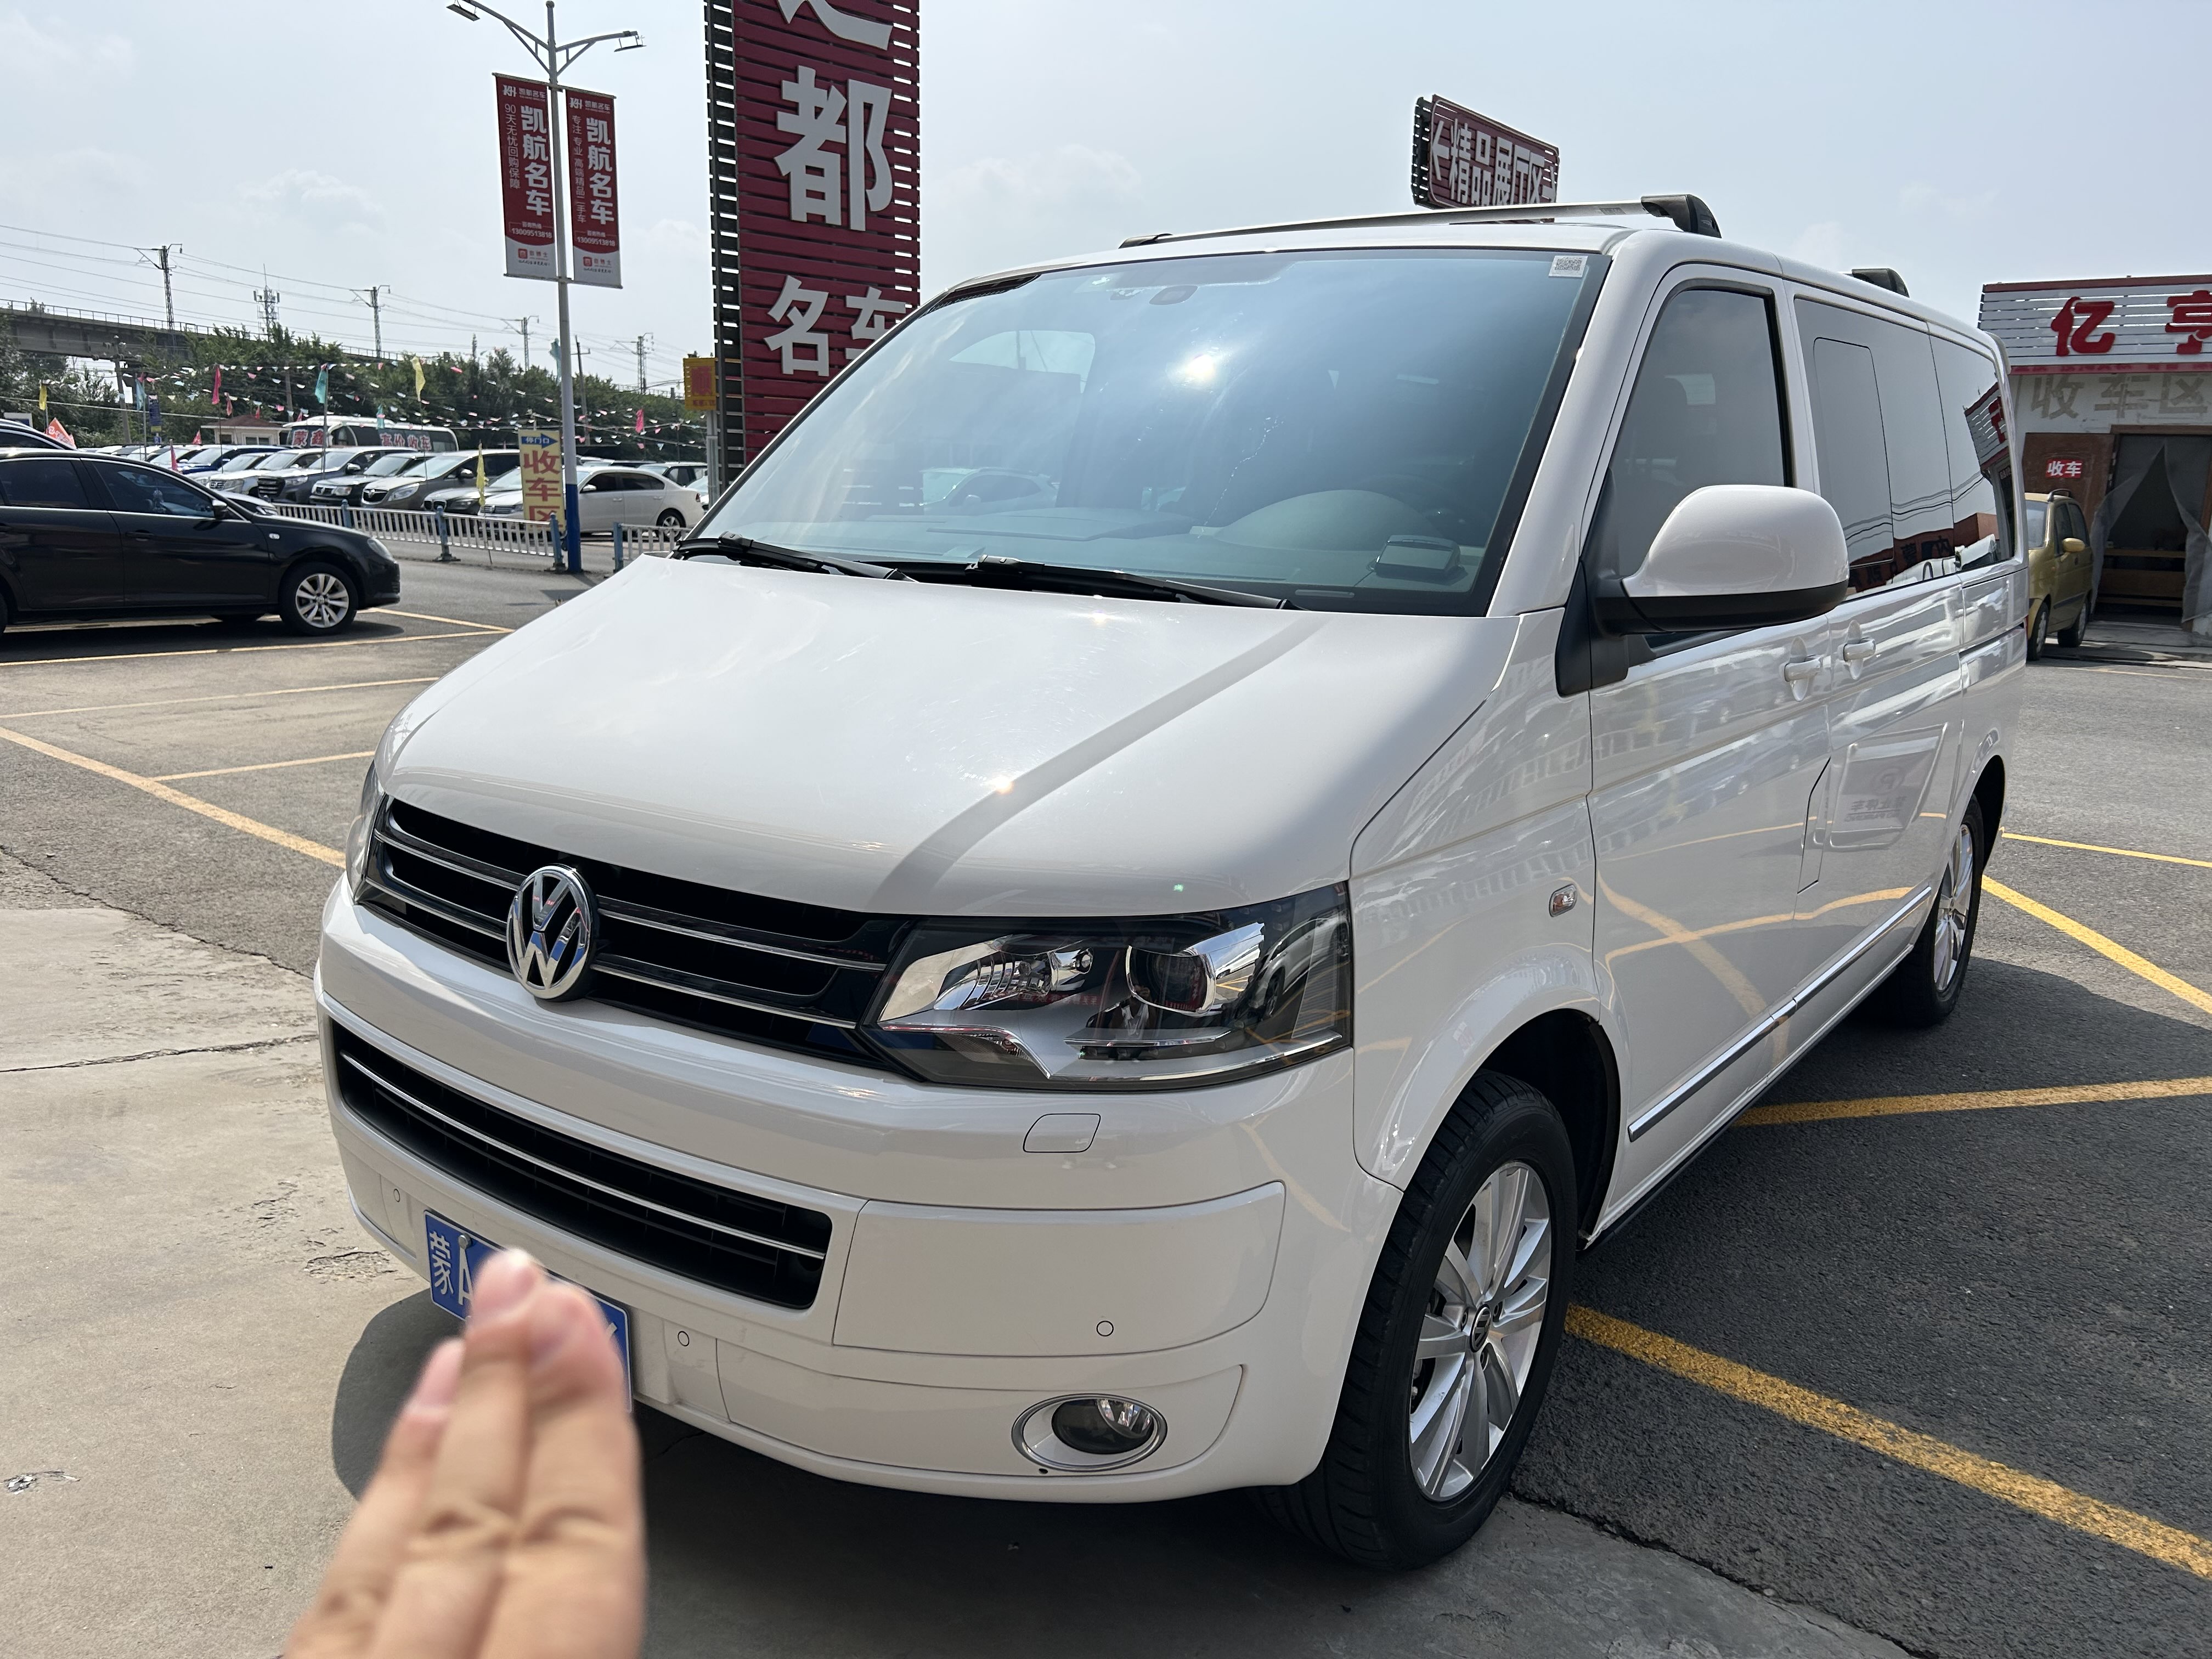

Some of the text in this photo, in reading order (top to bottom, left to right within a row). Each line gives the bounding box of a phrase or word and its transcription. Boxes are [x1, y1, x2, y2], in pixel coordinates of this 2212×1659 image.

[521, 105, 551, 216] 凯航名车
[586, 117, 614, 225] 凯航名车
[2047, 461, 2083, 477] 收车
